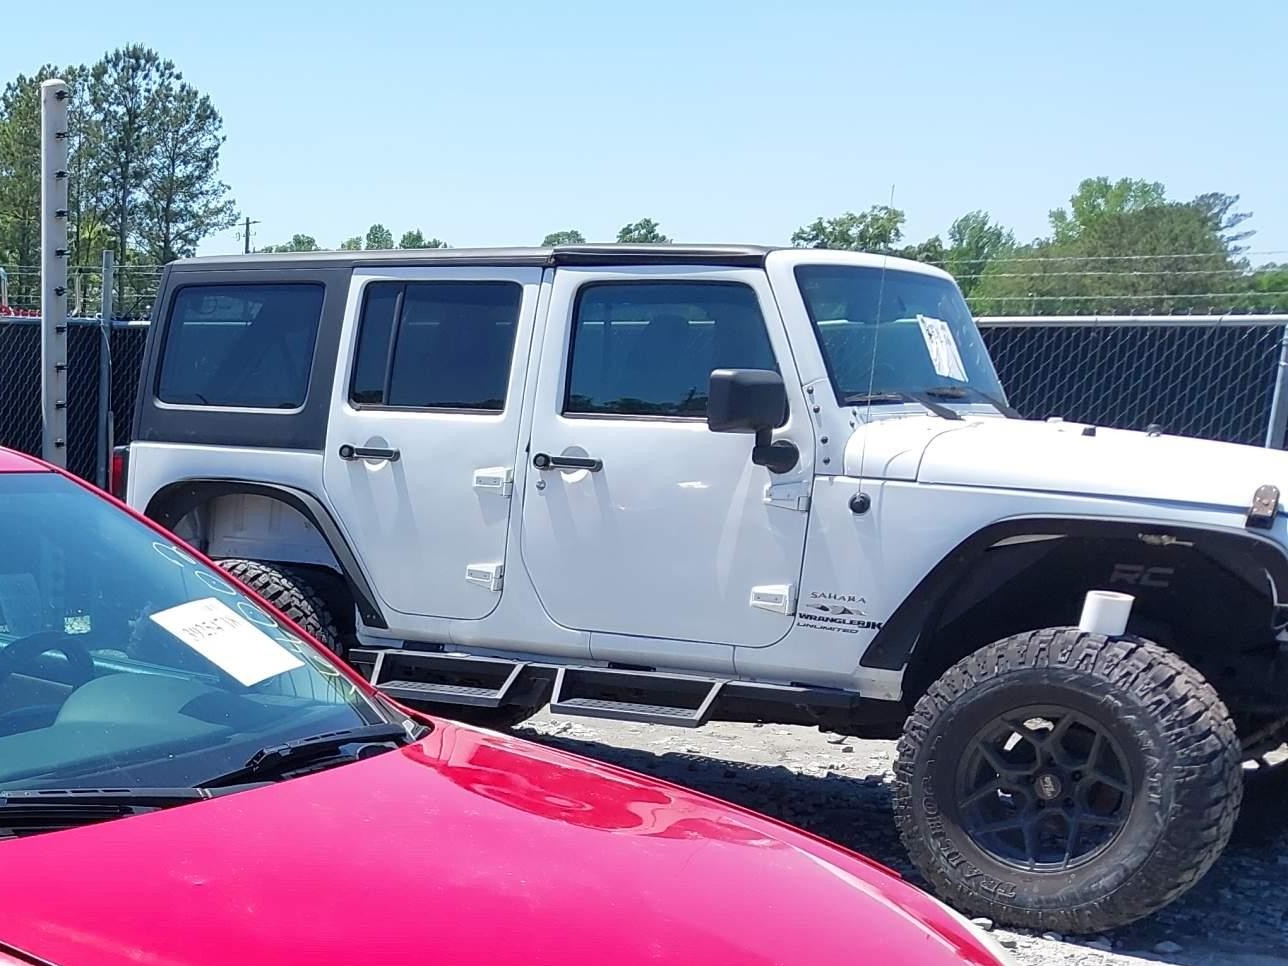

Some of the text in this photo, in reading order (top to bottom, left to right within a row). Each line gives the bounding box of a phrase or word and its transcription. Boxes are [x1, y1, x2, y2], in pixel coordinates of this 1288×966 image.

[1110, 563, 1175, 588] RC
[810, 591, 867, 604] SAHARA
[798, 612, 867, 627] WRANGLER
[796, 622, 859, 634] UNLIMITED
